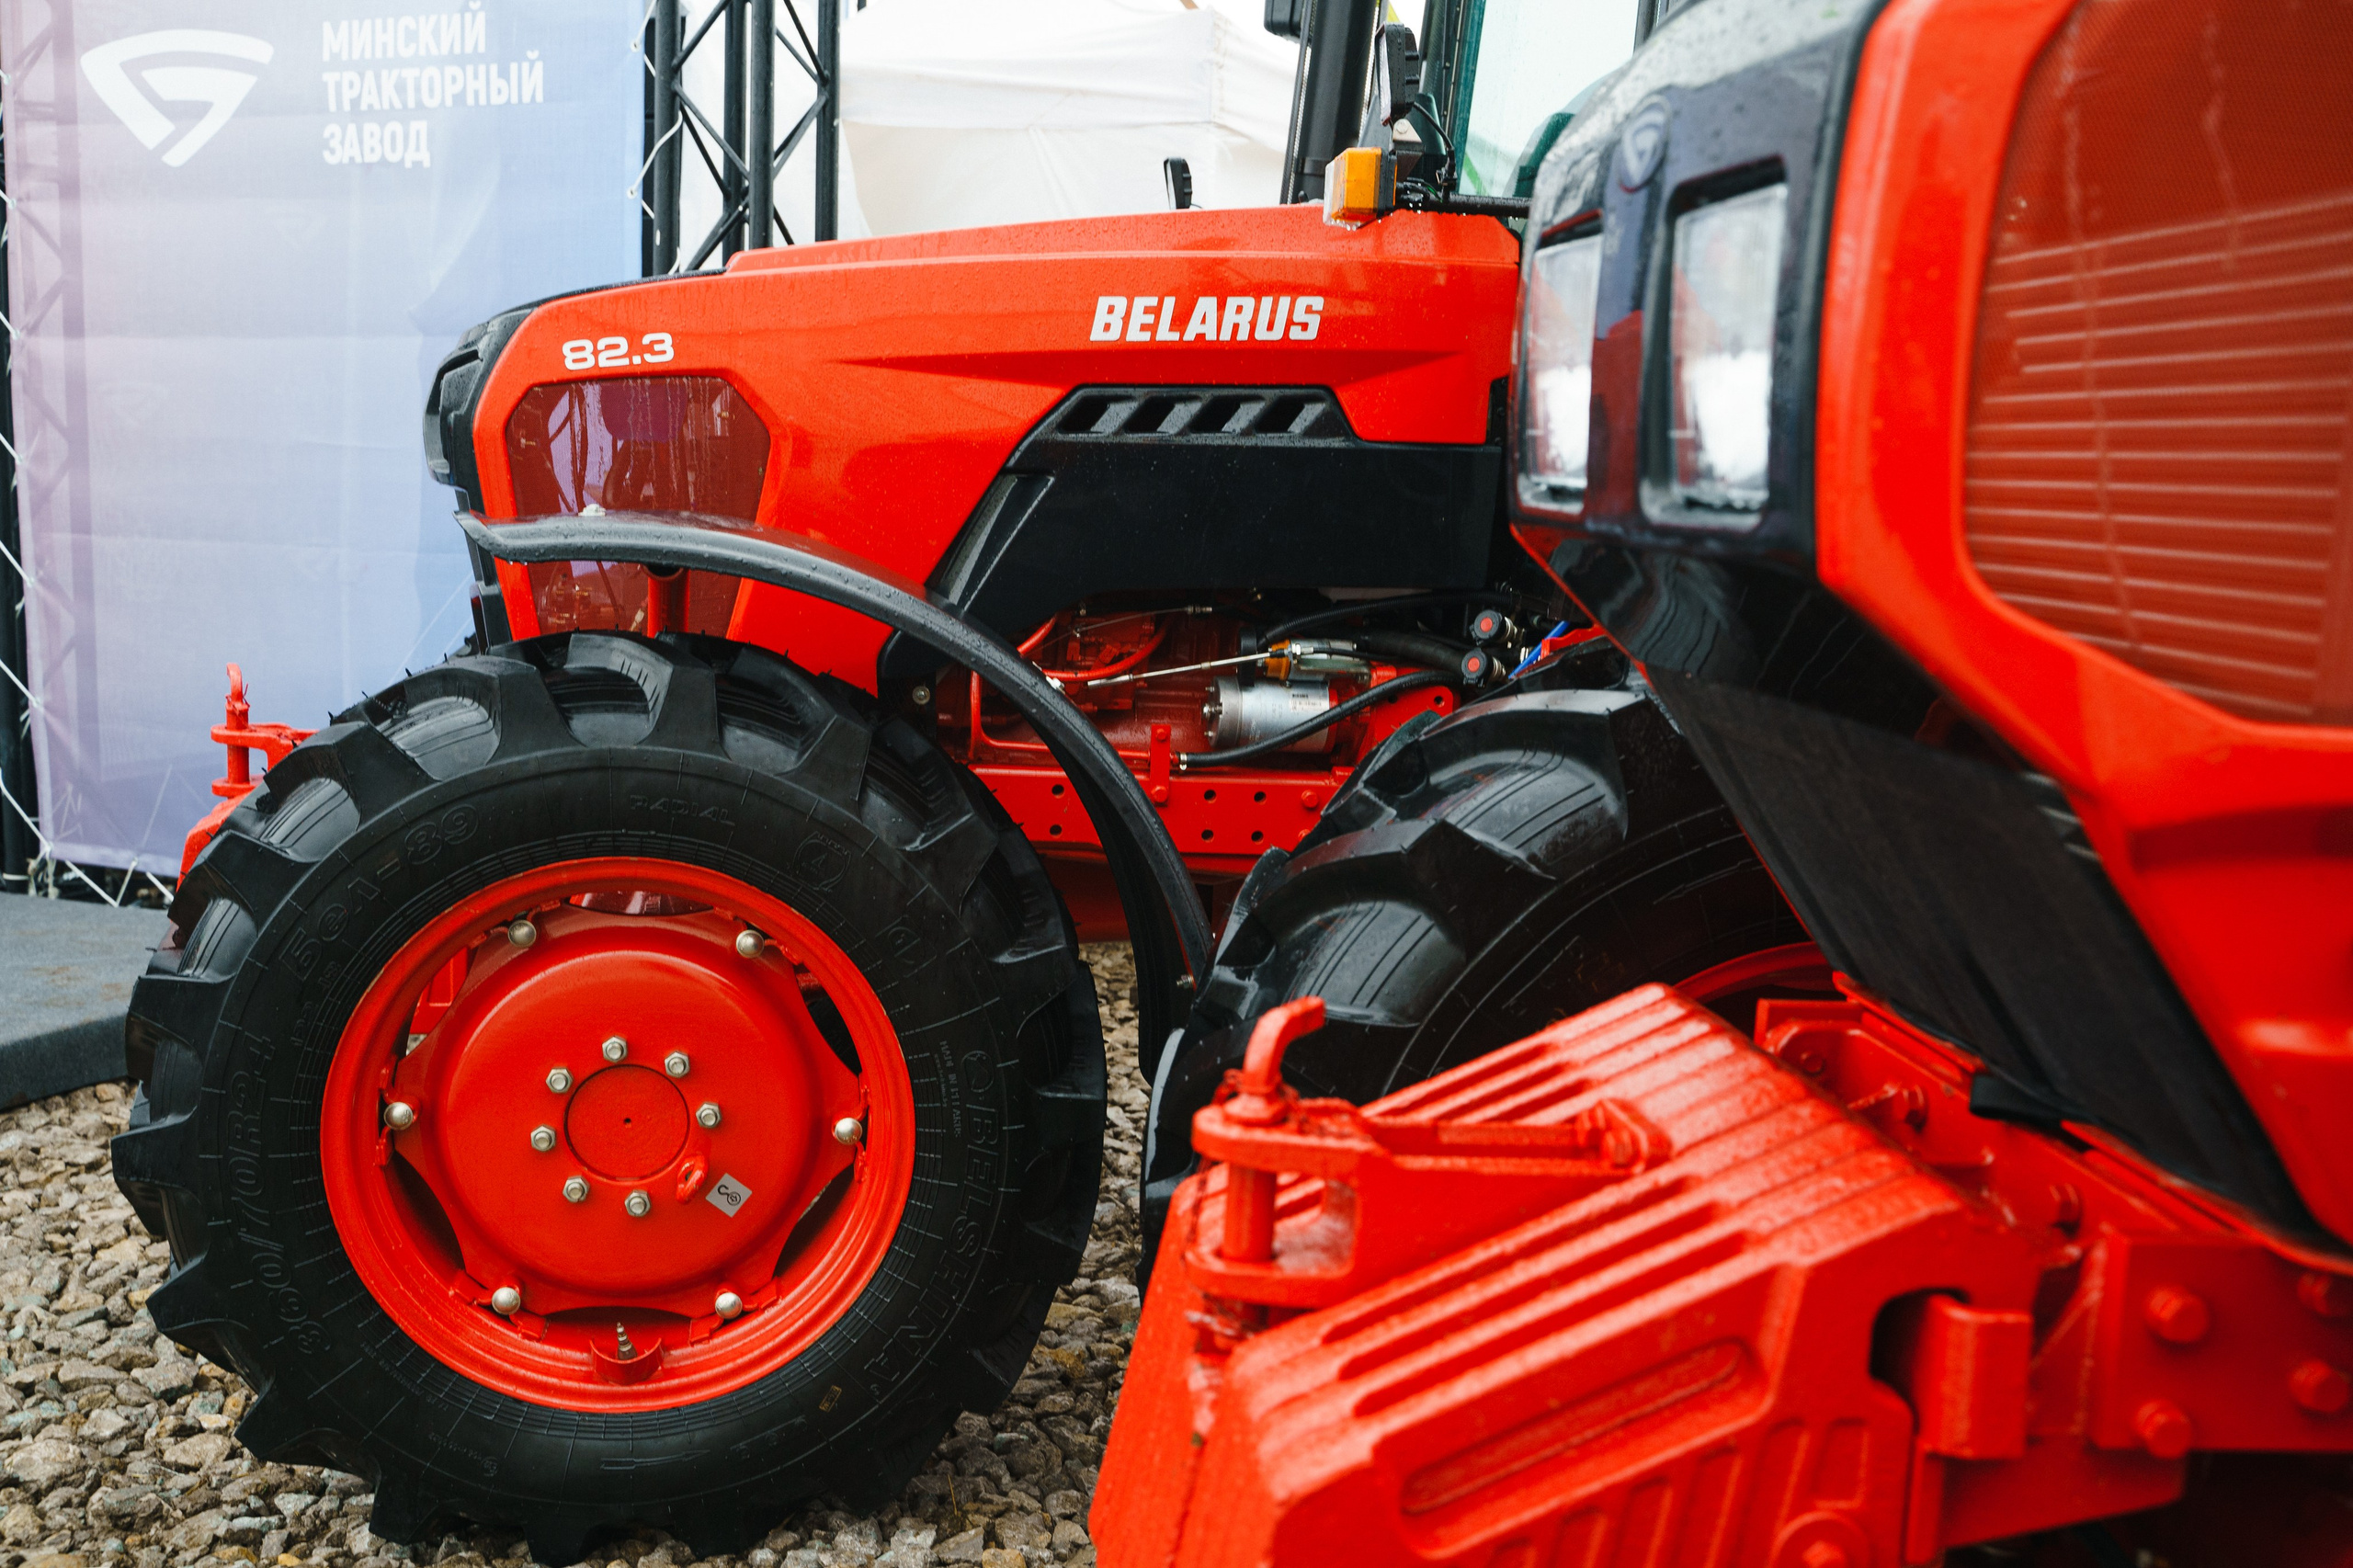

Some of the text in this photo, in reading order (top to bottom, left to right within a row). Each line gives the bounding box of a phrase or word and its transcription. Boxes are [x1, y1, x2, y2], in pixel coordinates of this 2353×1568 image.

[322, 0, 486, 62] МИНСКИЙ
[322, 50, 544, 112] ТРАКТОРНЫЙ
[322, 120, 431, 168] ЗАВОД
[1089, 295, 1324, 342] BELARUS
[562, 332, 675, 370] 82.3
[630, 794, 735, 826] RADIAL
[864, 1103, 999, 1382] BELSHINA
